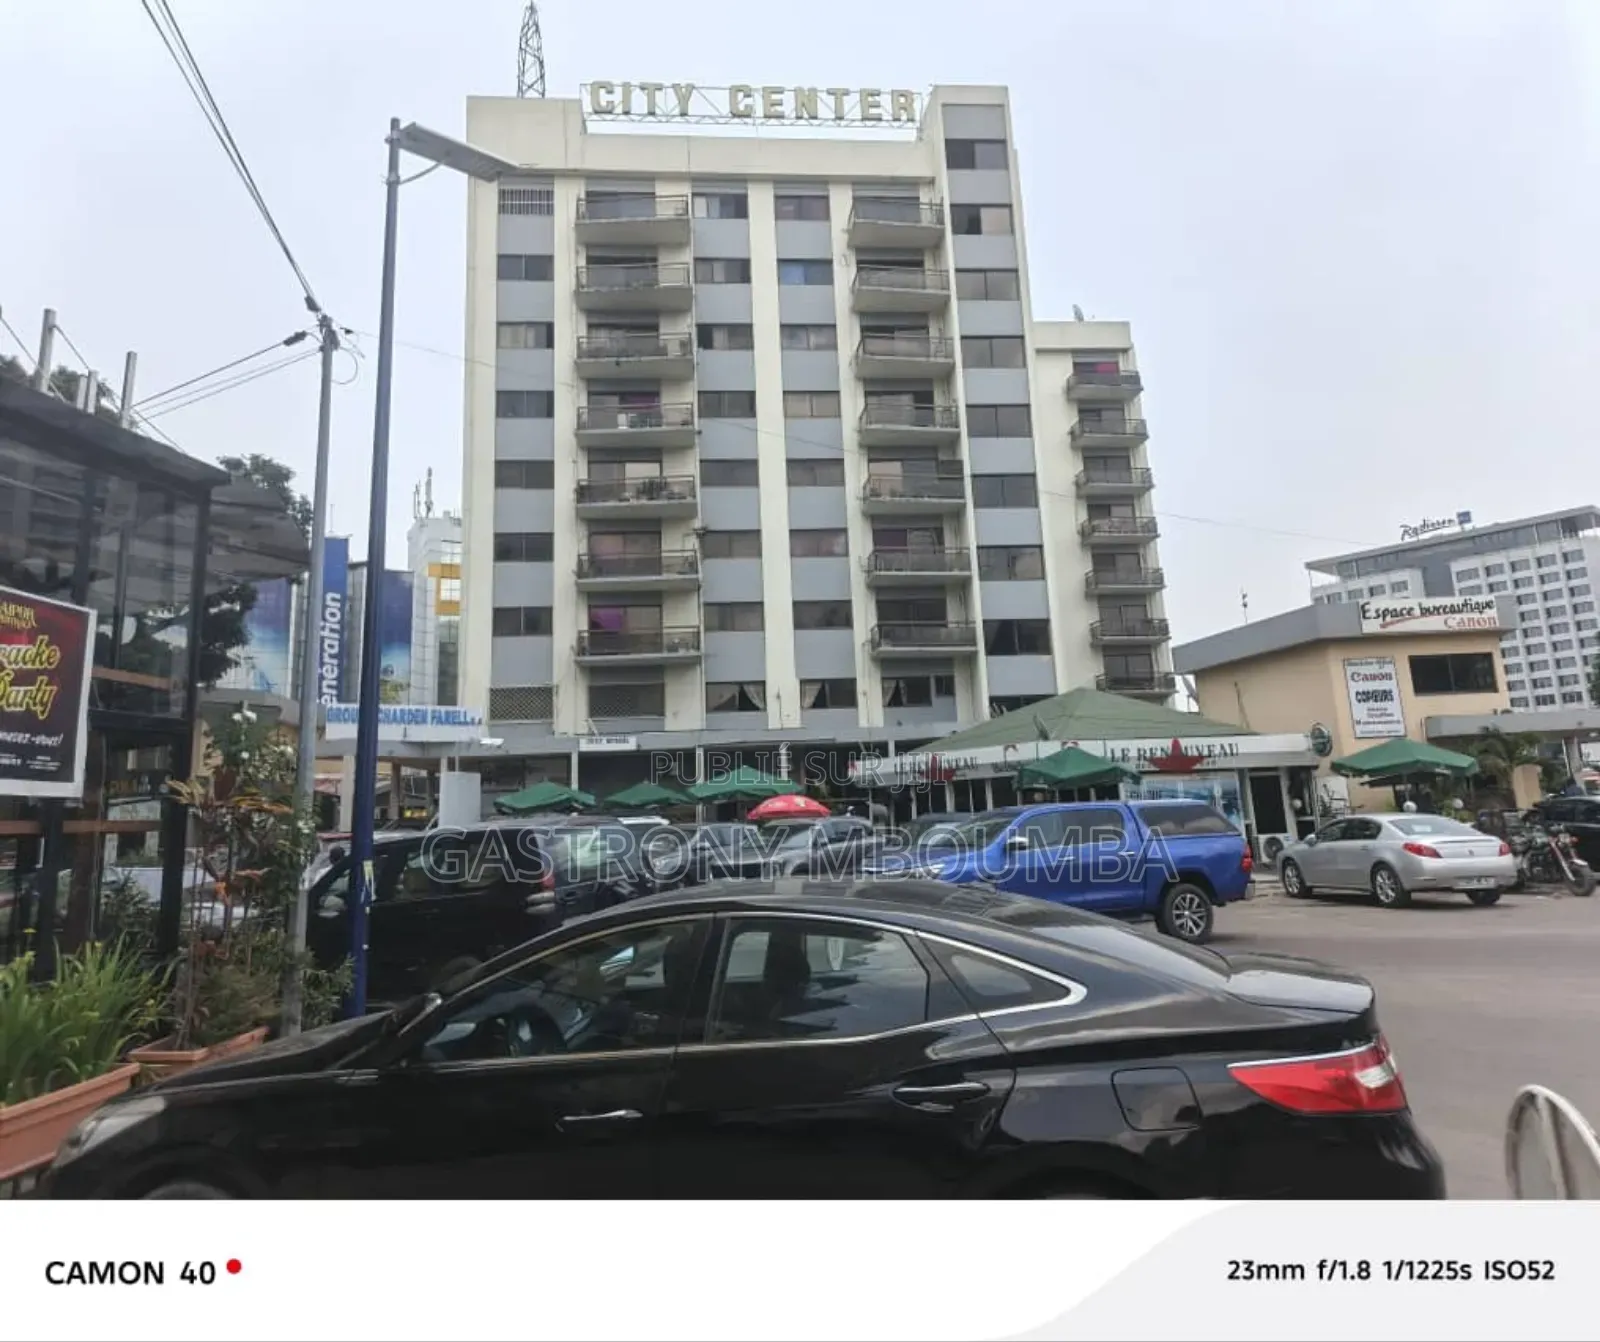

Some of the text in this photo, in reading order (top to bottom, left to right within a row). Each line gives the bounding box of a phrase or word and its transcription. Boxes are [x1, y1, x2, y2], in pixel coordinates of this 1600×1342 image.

[590, 80, 915, 121] CITY CENTER
[1361, 598, 1495, 622] Espace bureautique
[1443, 616, 1497, 629] Canon
[1351, 671, 1393, 682] Canon
[1110, 743, 1239, 762] LE RENUVEAU
